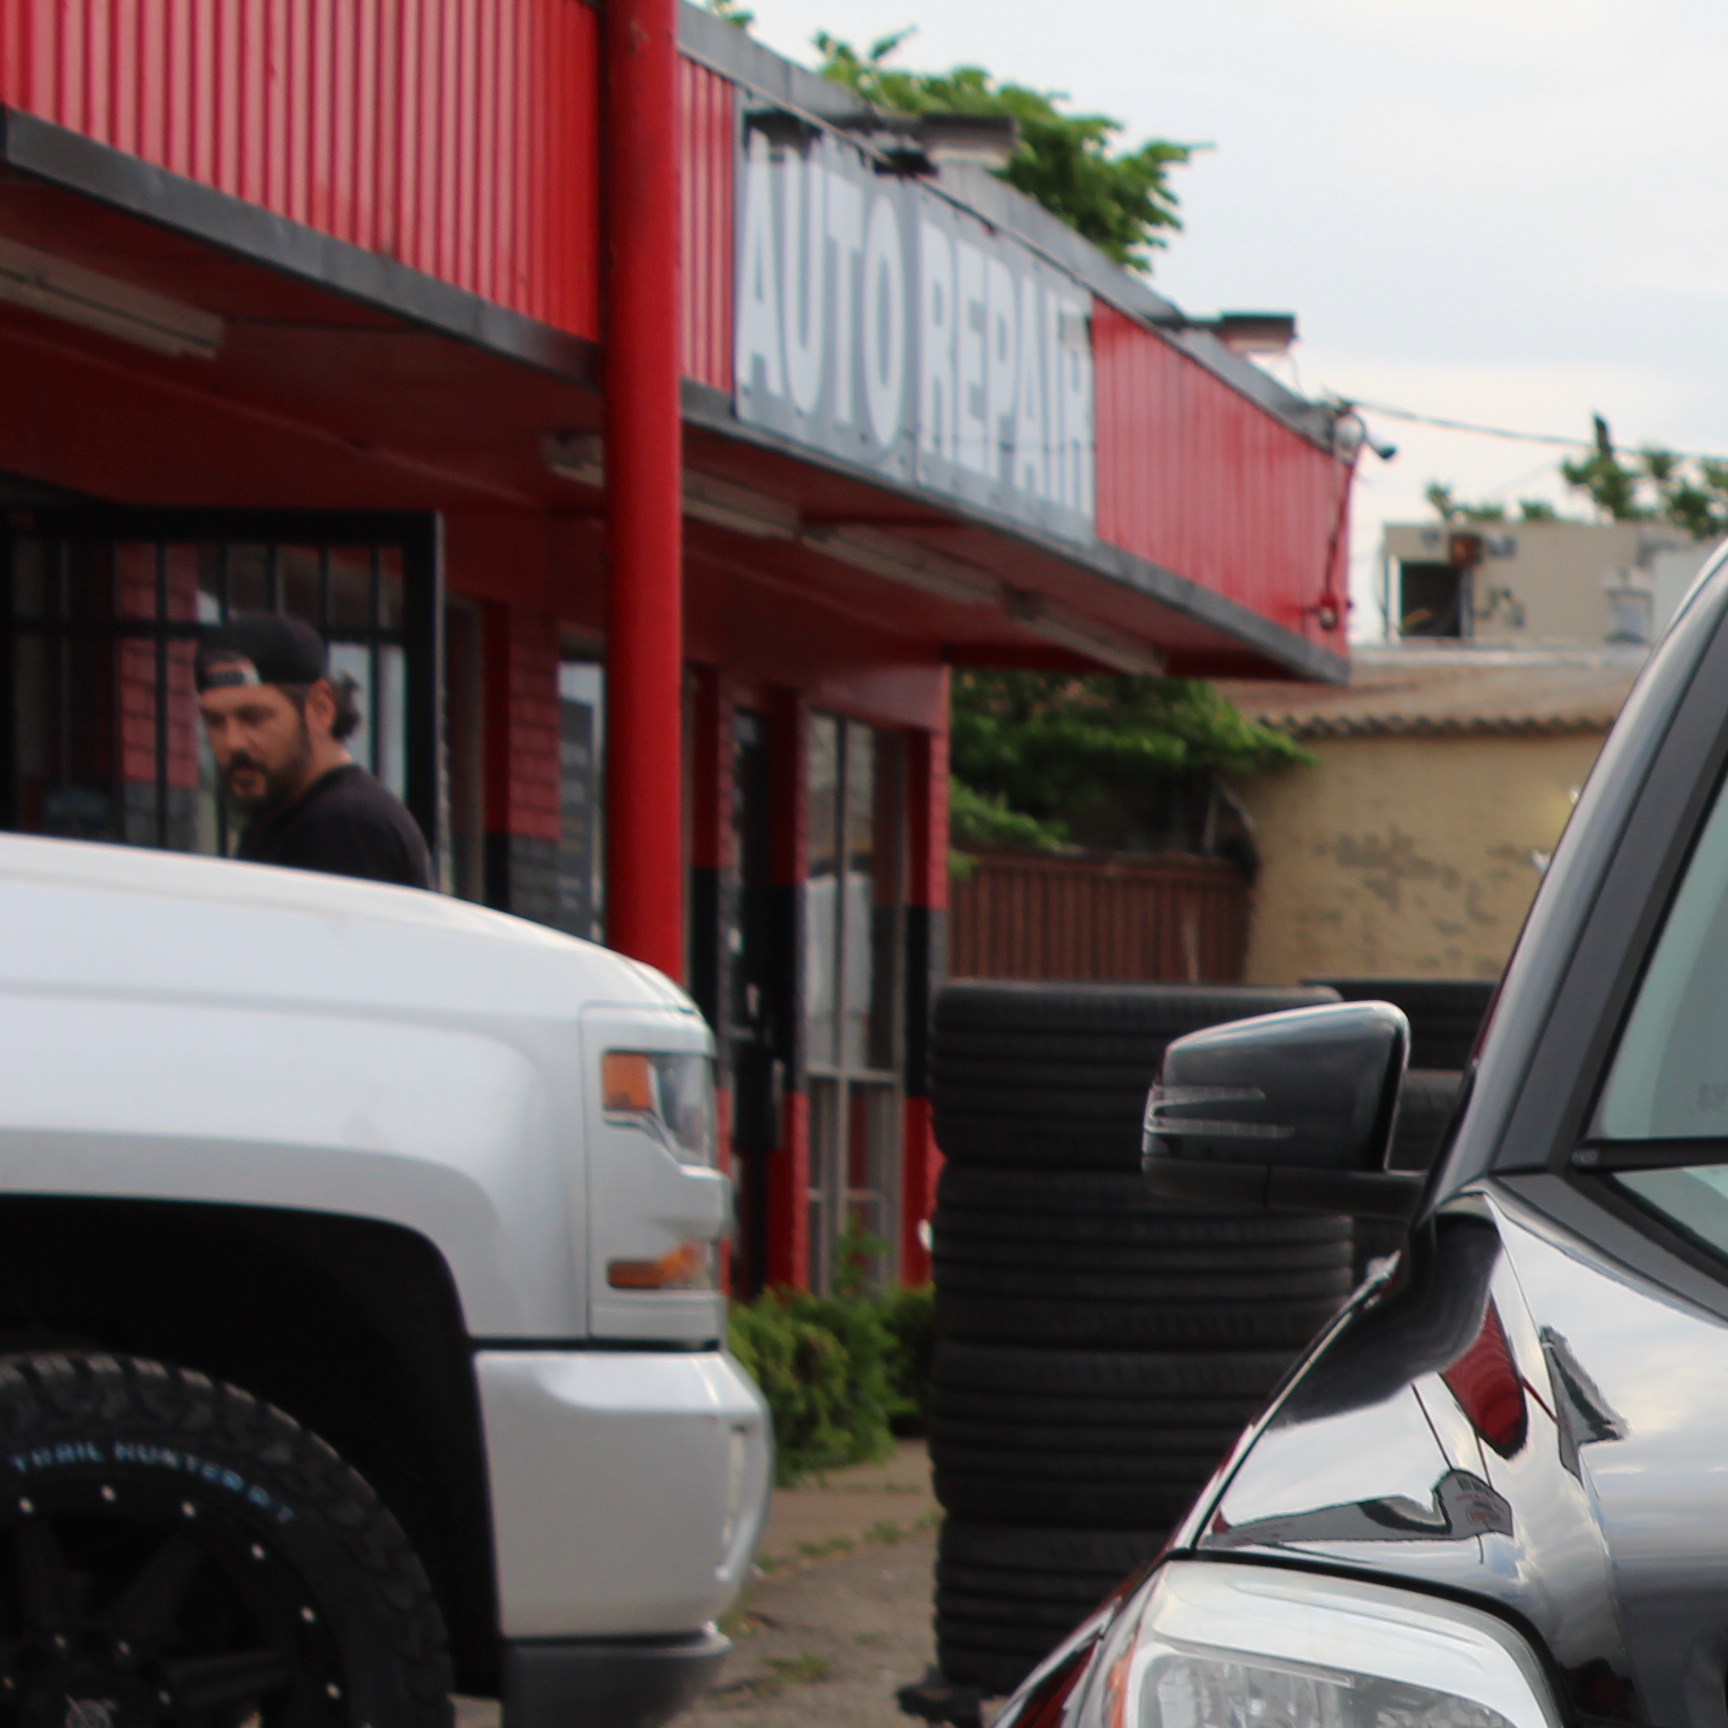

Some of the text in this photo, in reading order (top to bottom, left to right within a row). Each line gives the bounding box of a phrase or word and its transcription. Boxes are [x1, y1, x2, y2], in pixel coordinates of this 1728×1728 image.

[737, 127, 1095, 519] AUTO REPAIR
[114, 1441, 244, 1491] HUNTER
